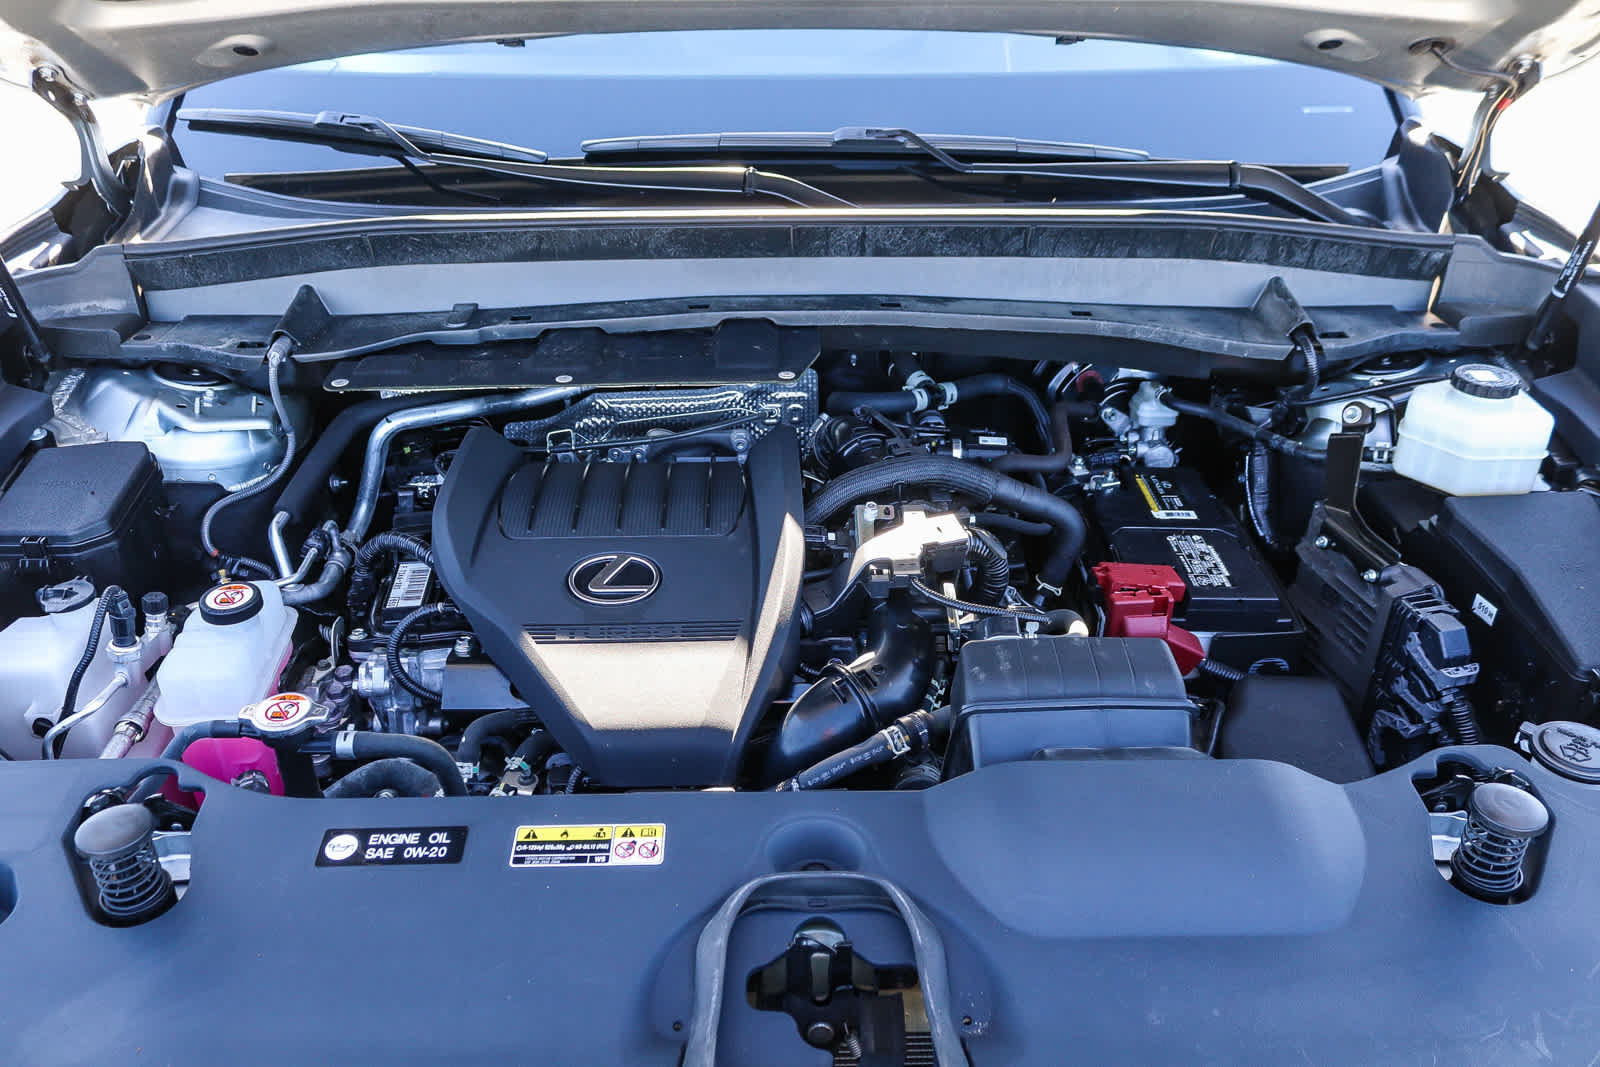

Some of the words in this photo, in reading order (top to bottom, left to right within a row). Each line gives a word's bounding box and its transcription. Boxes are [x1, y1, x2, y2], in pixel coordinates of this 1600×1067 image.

[368, 832, 421, 845] ENGINE
[429, 831, 452, 843] OIL
[364, 847, 395, 859] SAE
[403, 845, 447, 858] 0W-20
